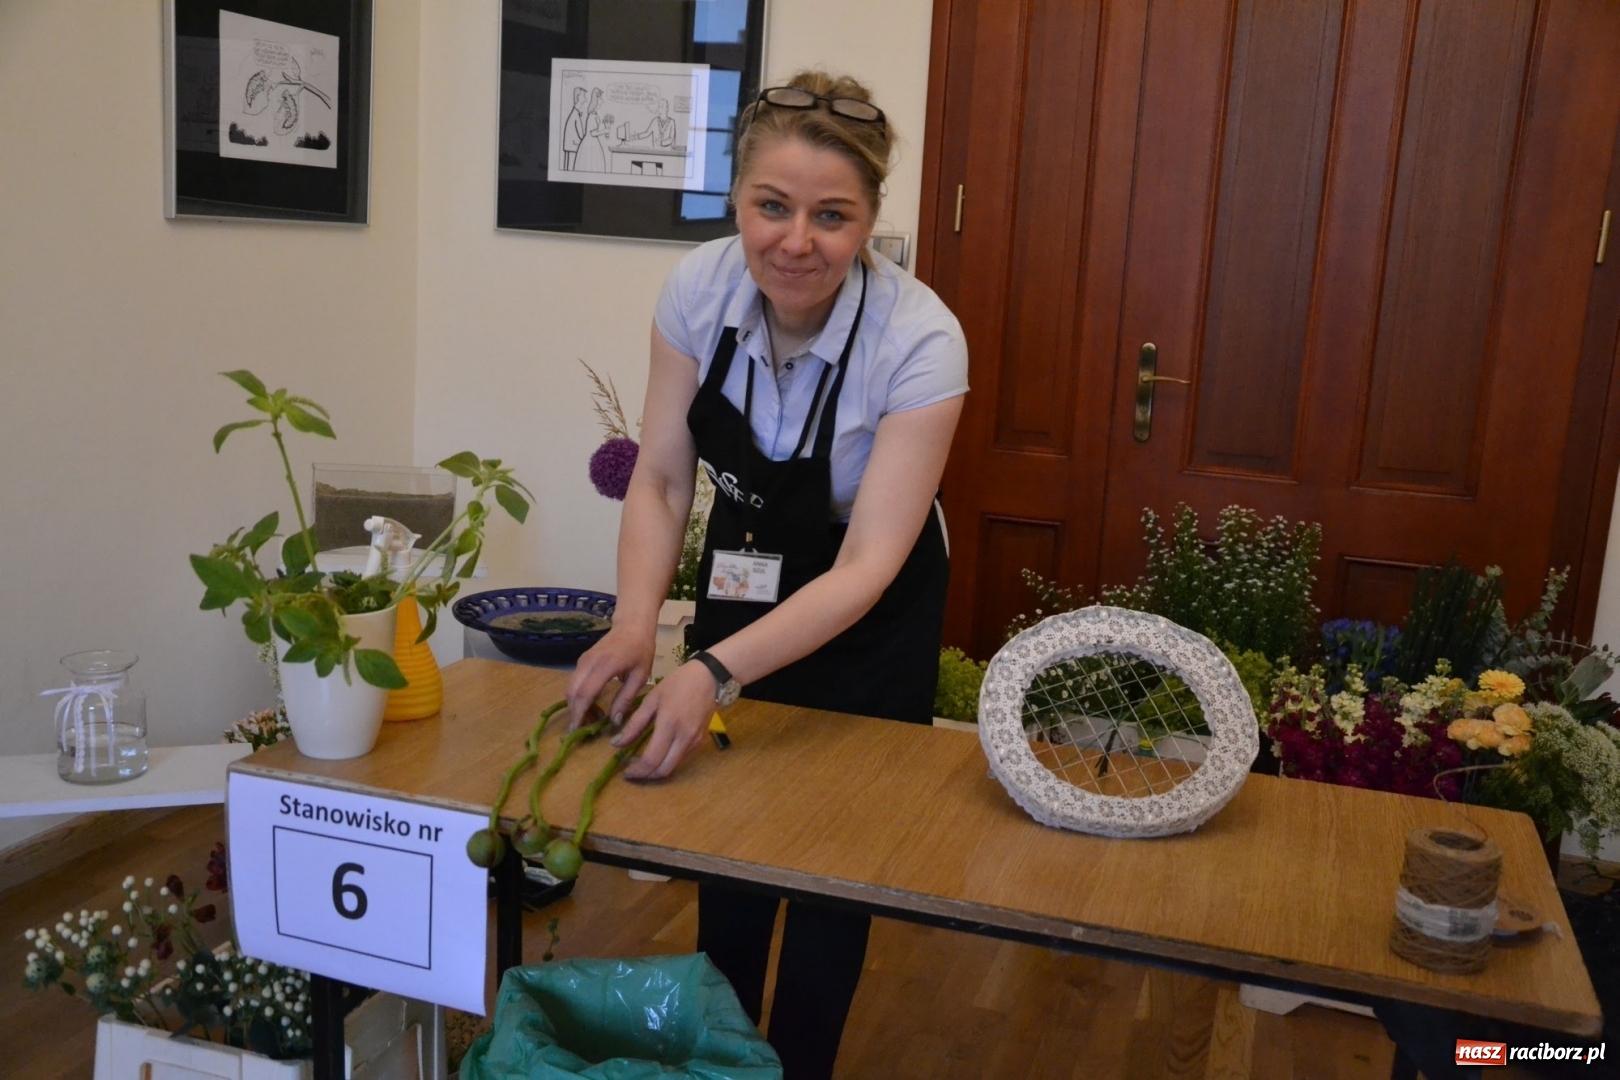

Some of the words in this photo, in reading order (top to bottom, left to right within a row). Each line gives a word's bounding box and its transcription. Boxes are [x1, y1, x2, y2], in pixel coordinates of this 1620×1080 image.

[279, 794, 411, 837] Stanowisko
[418, 823, 443, 842] nr
[331, 861, 369, 920] 6
